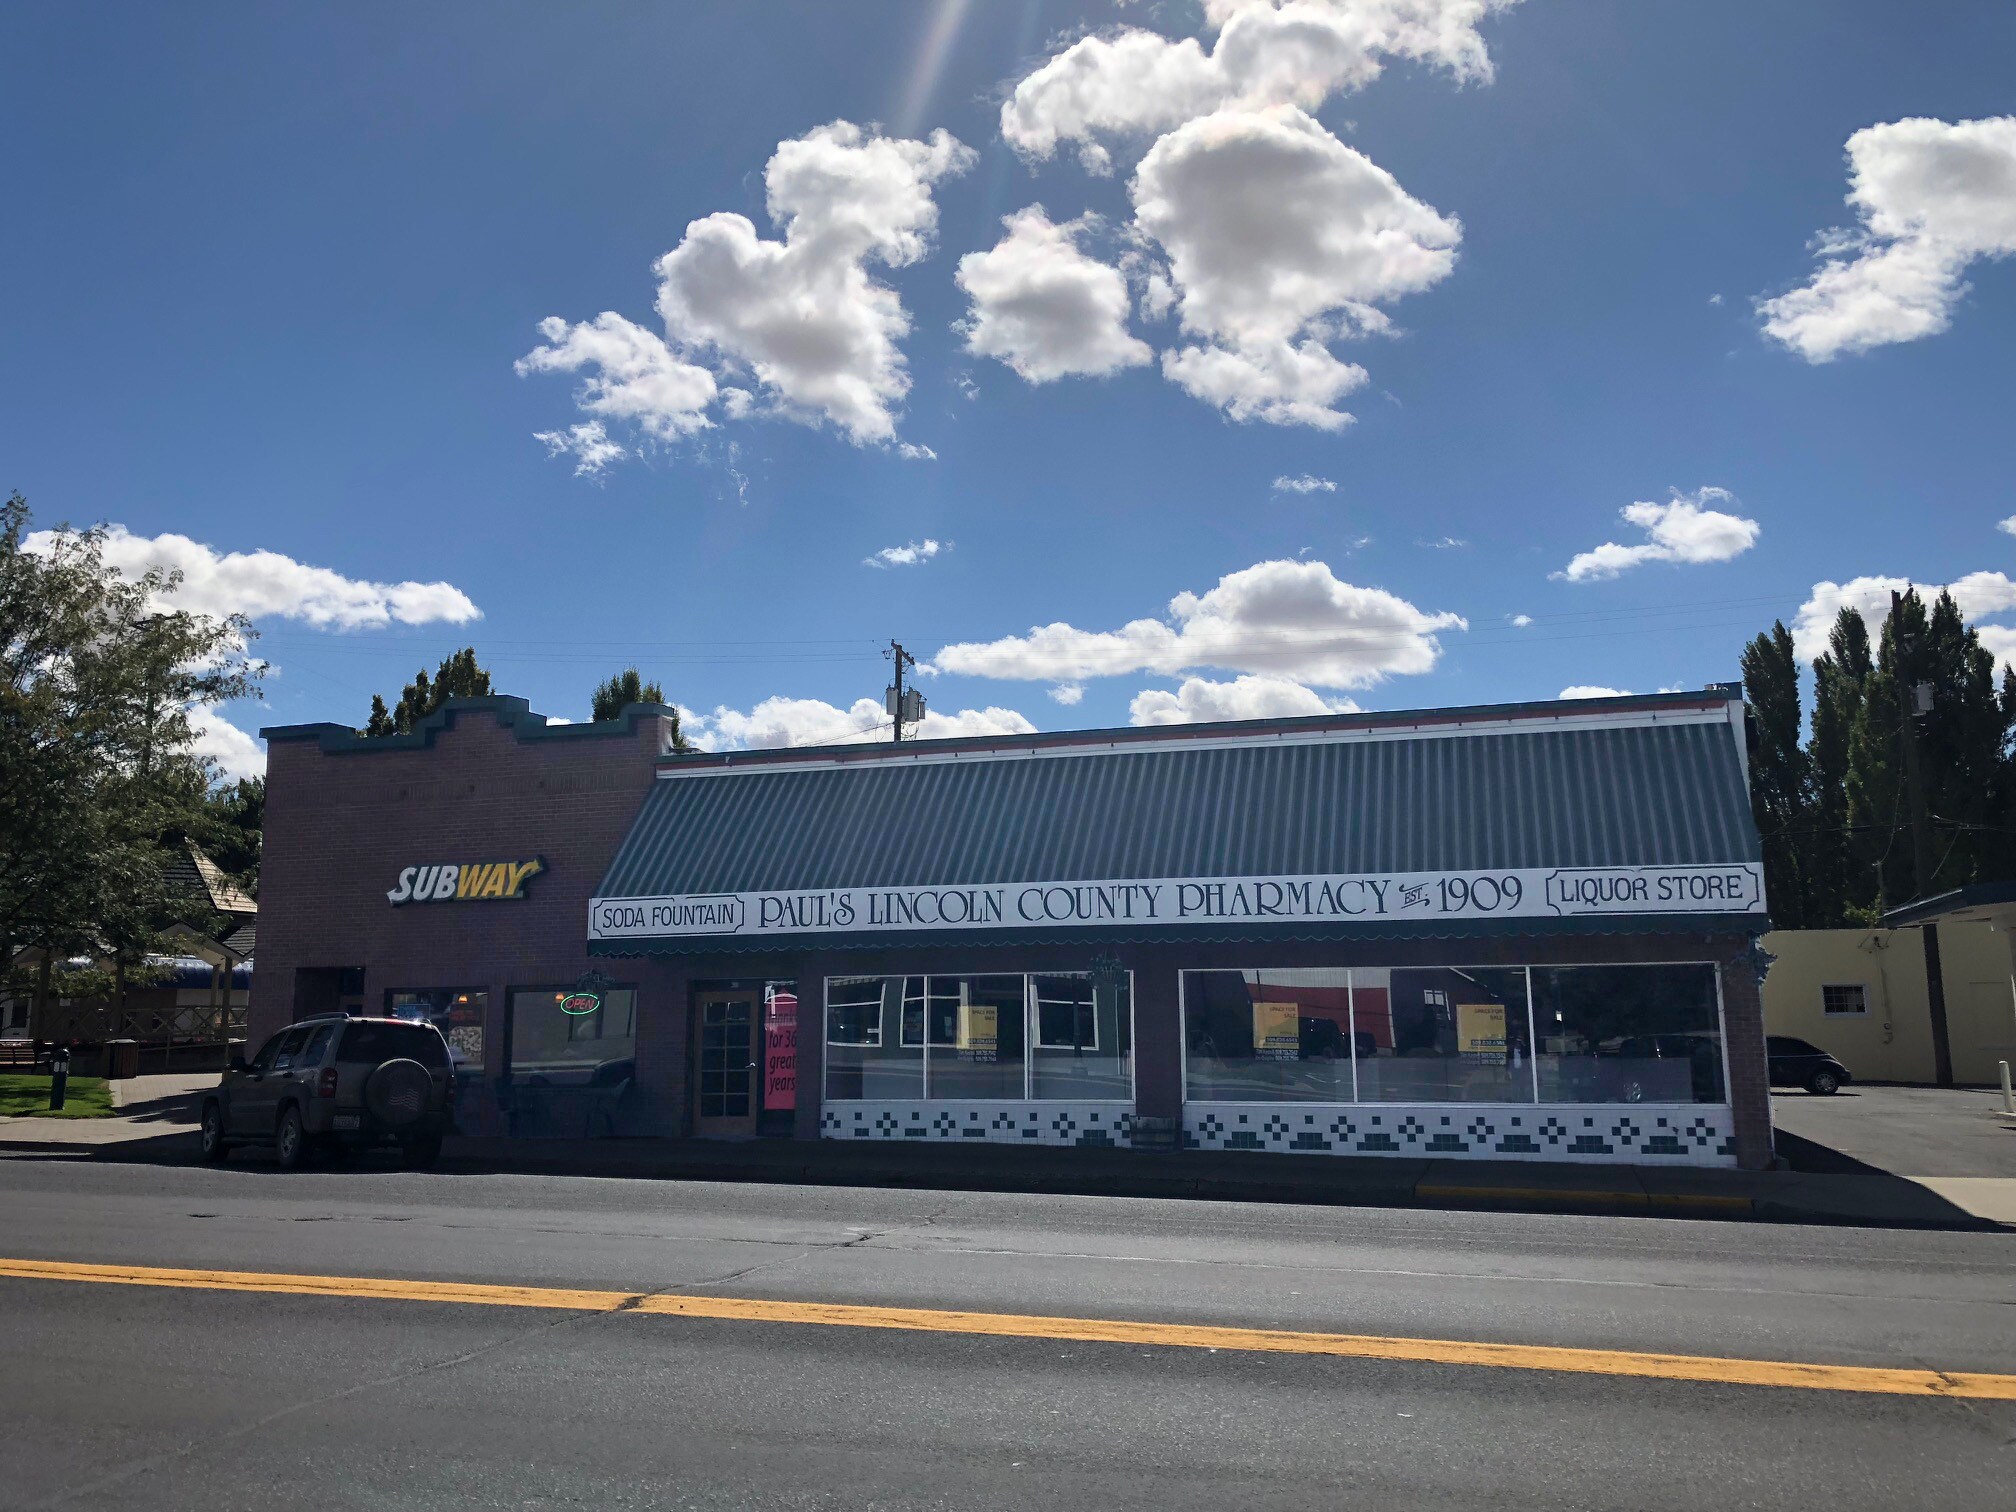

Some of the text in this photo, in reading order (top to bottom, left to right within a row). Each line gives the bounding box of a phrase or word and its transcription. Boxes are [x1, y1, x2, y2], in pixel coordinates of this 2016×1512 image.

[387, 859, 543, 905] SUBWAY
[1559, 873, 1743, 904] LIQUOR STORE
[758, 892, 856, 929] PAUL'S
[867, 889, 1005, 926] LINCOLN
[1017, 884, 1164, 922] COUNTY
[1177, 879, 1392, 918] PHARMACY
[1436, 875, 1523, 912] 1909
[602, 902, 735, 929] SODA FOUNTAIN
[566, 998, 596, 1010] OPEN
[769, 1030, 783, 1048] for
[769, 1053, 796, 1075] great
[769, 1077, 796, 1096] years
